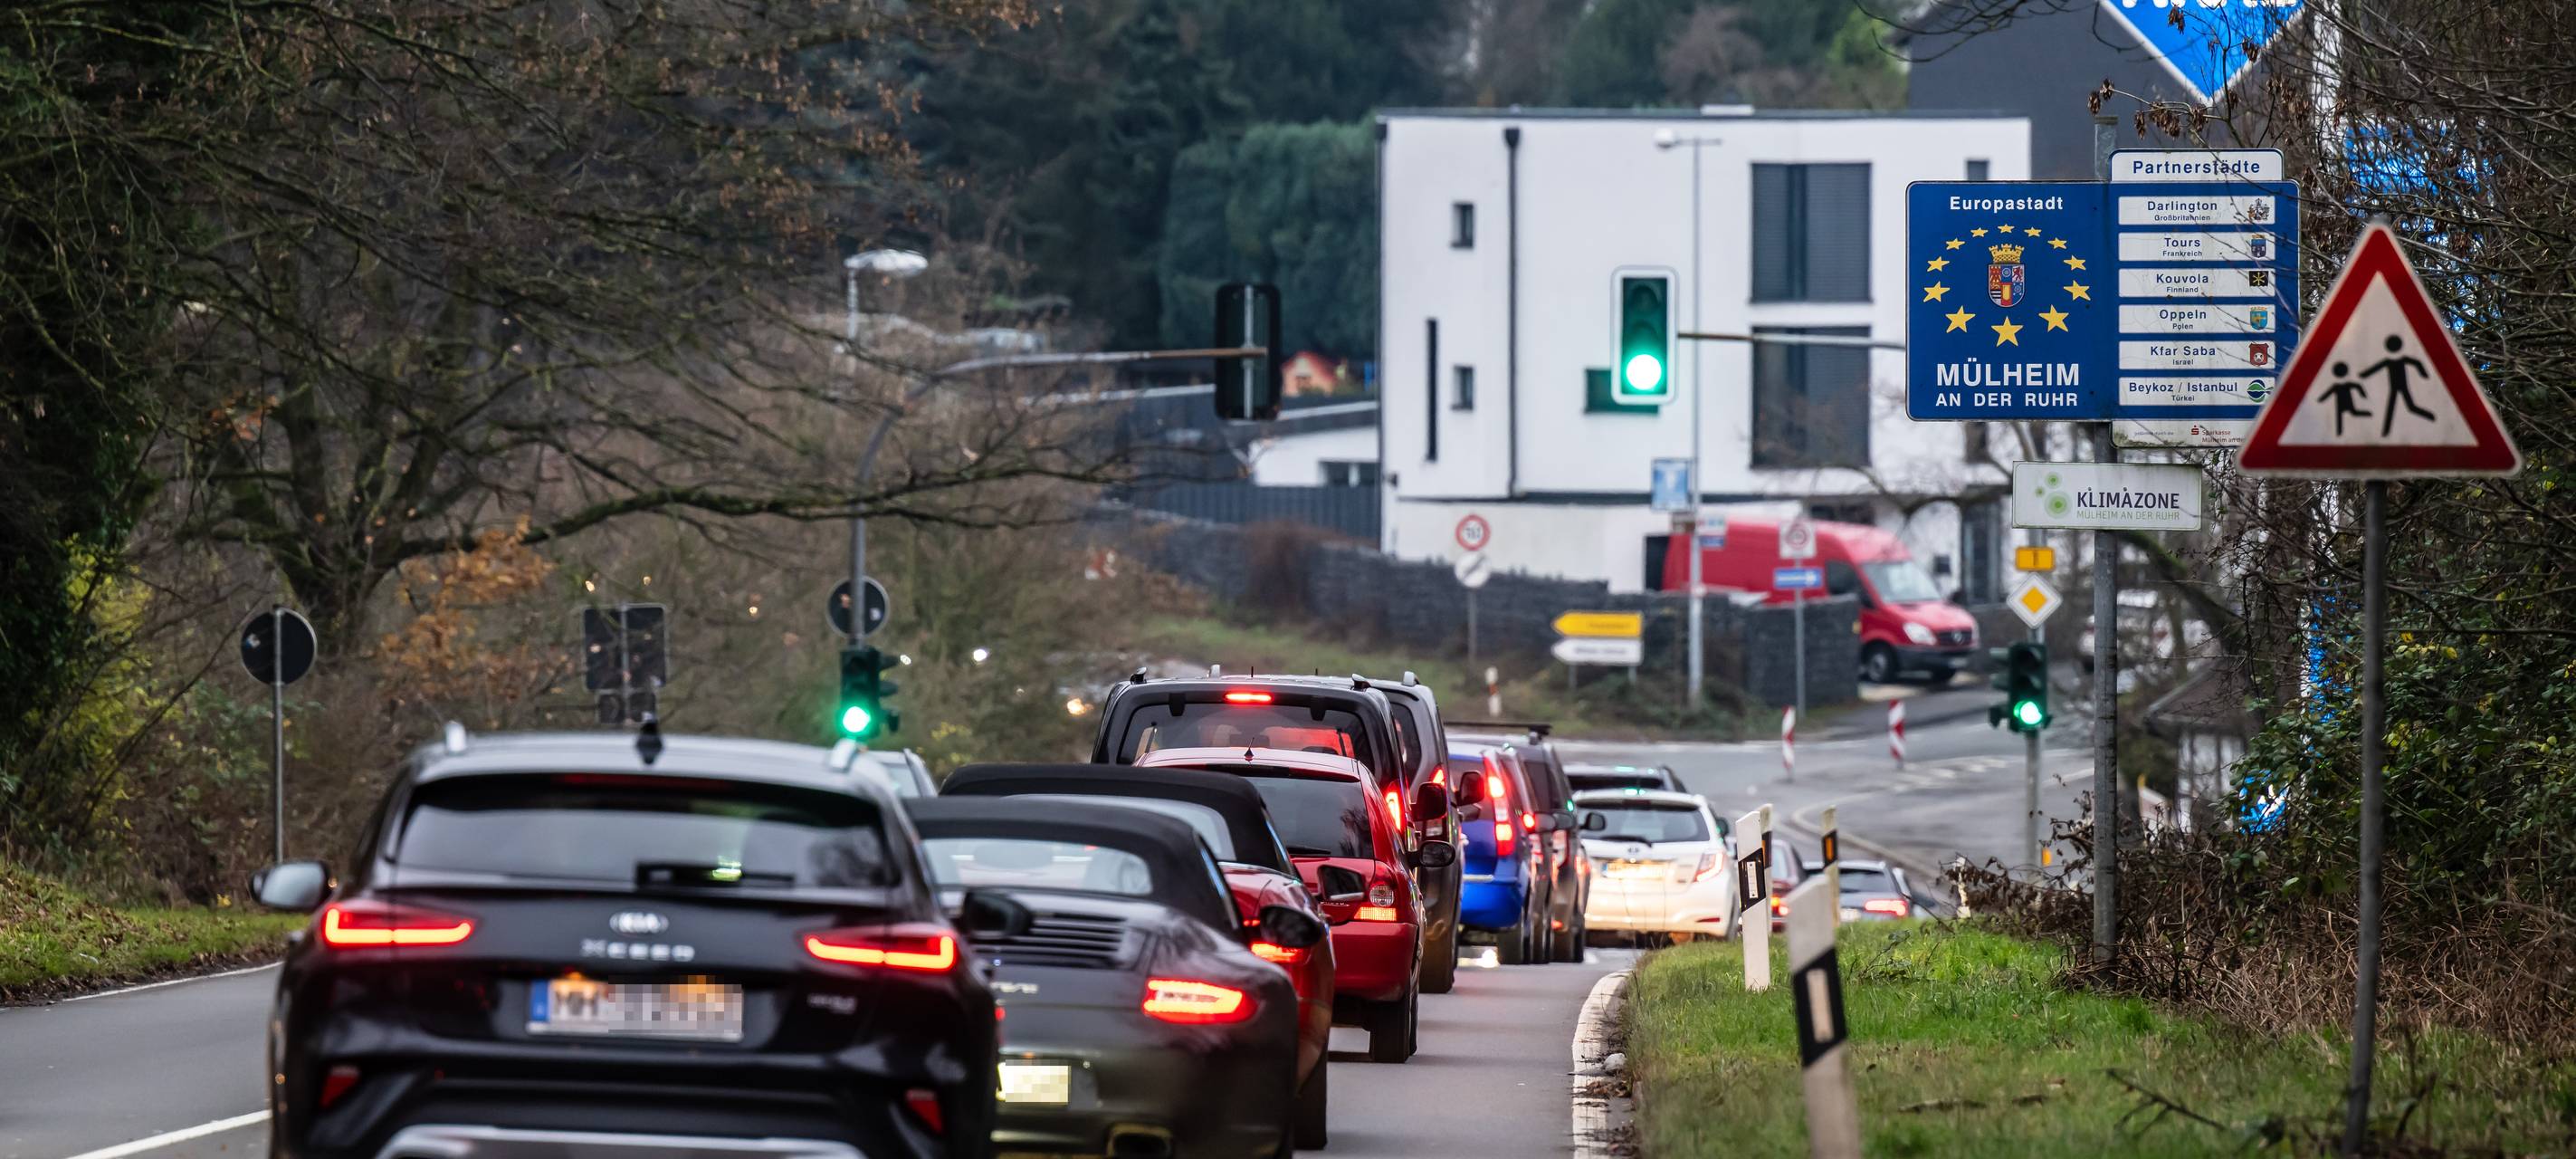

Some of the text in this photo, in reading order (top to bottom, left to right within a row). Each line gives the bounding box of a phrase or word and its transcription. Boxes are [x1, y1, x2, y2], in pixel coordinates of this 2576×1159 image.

[2132, 159, 2260, 174] Partnerstädte
[1950, 196, 2063, 213] Europastadt
[2147, 200, 2218, 213] Darlington
[2154, 214, 2211, 222] Großbritannien
[2164, 237, 2201, 247] Tours
[2156, 273, 2209, 283] Kouvola
[2159, 309, 2207, 321] Oppeln
[2151, 346, 2216, 356] Kfar Saba
[1936, 357, 2079, 387] MÜLHEIM
[2129, 382, 2174, 394] Beykoz
[2187, 382, 2237, 392] Istanbul
[1935, 392, 2078, 407] AN DER RUHR
[2077, 492, 2180, 509] KLIMAZONE
[2076, 509, 2180, 521] MÜLHEIM AN DER RUHR
